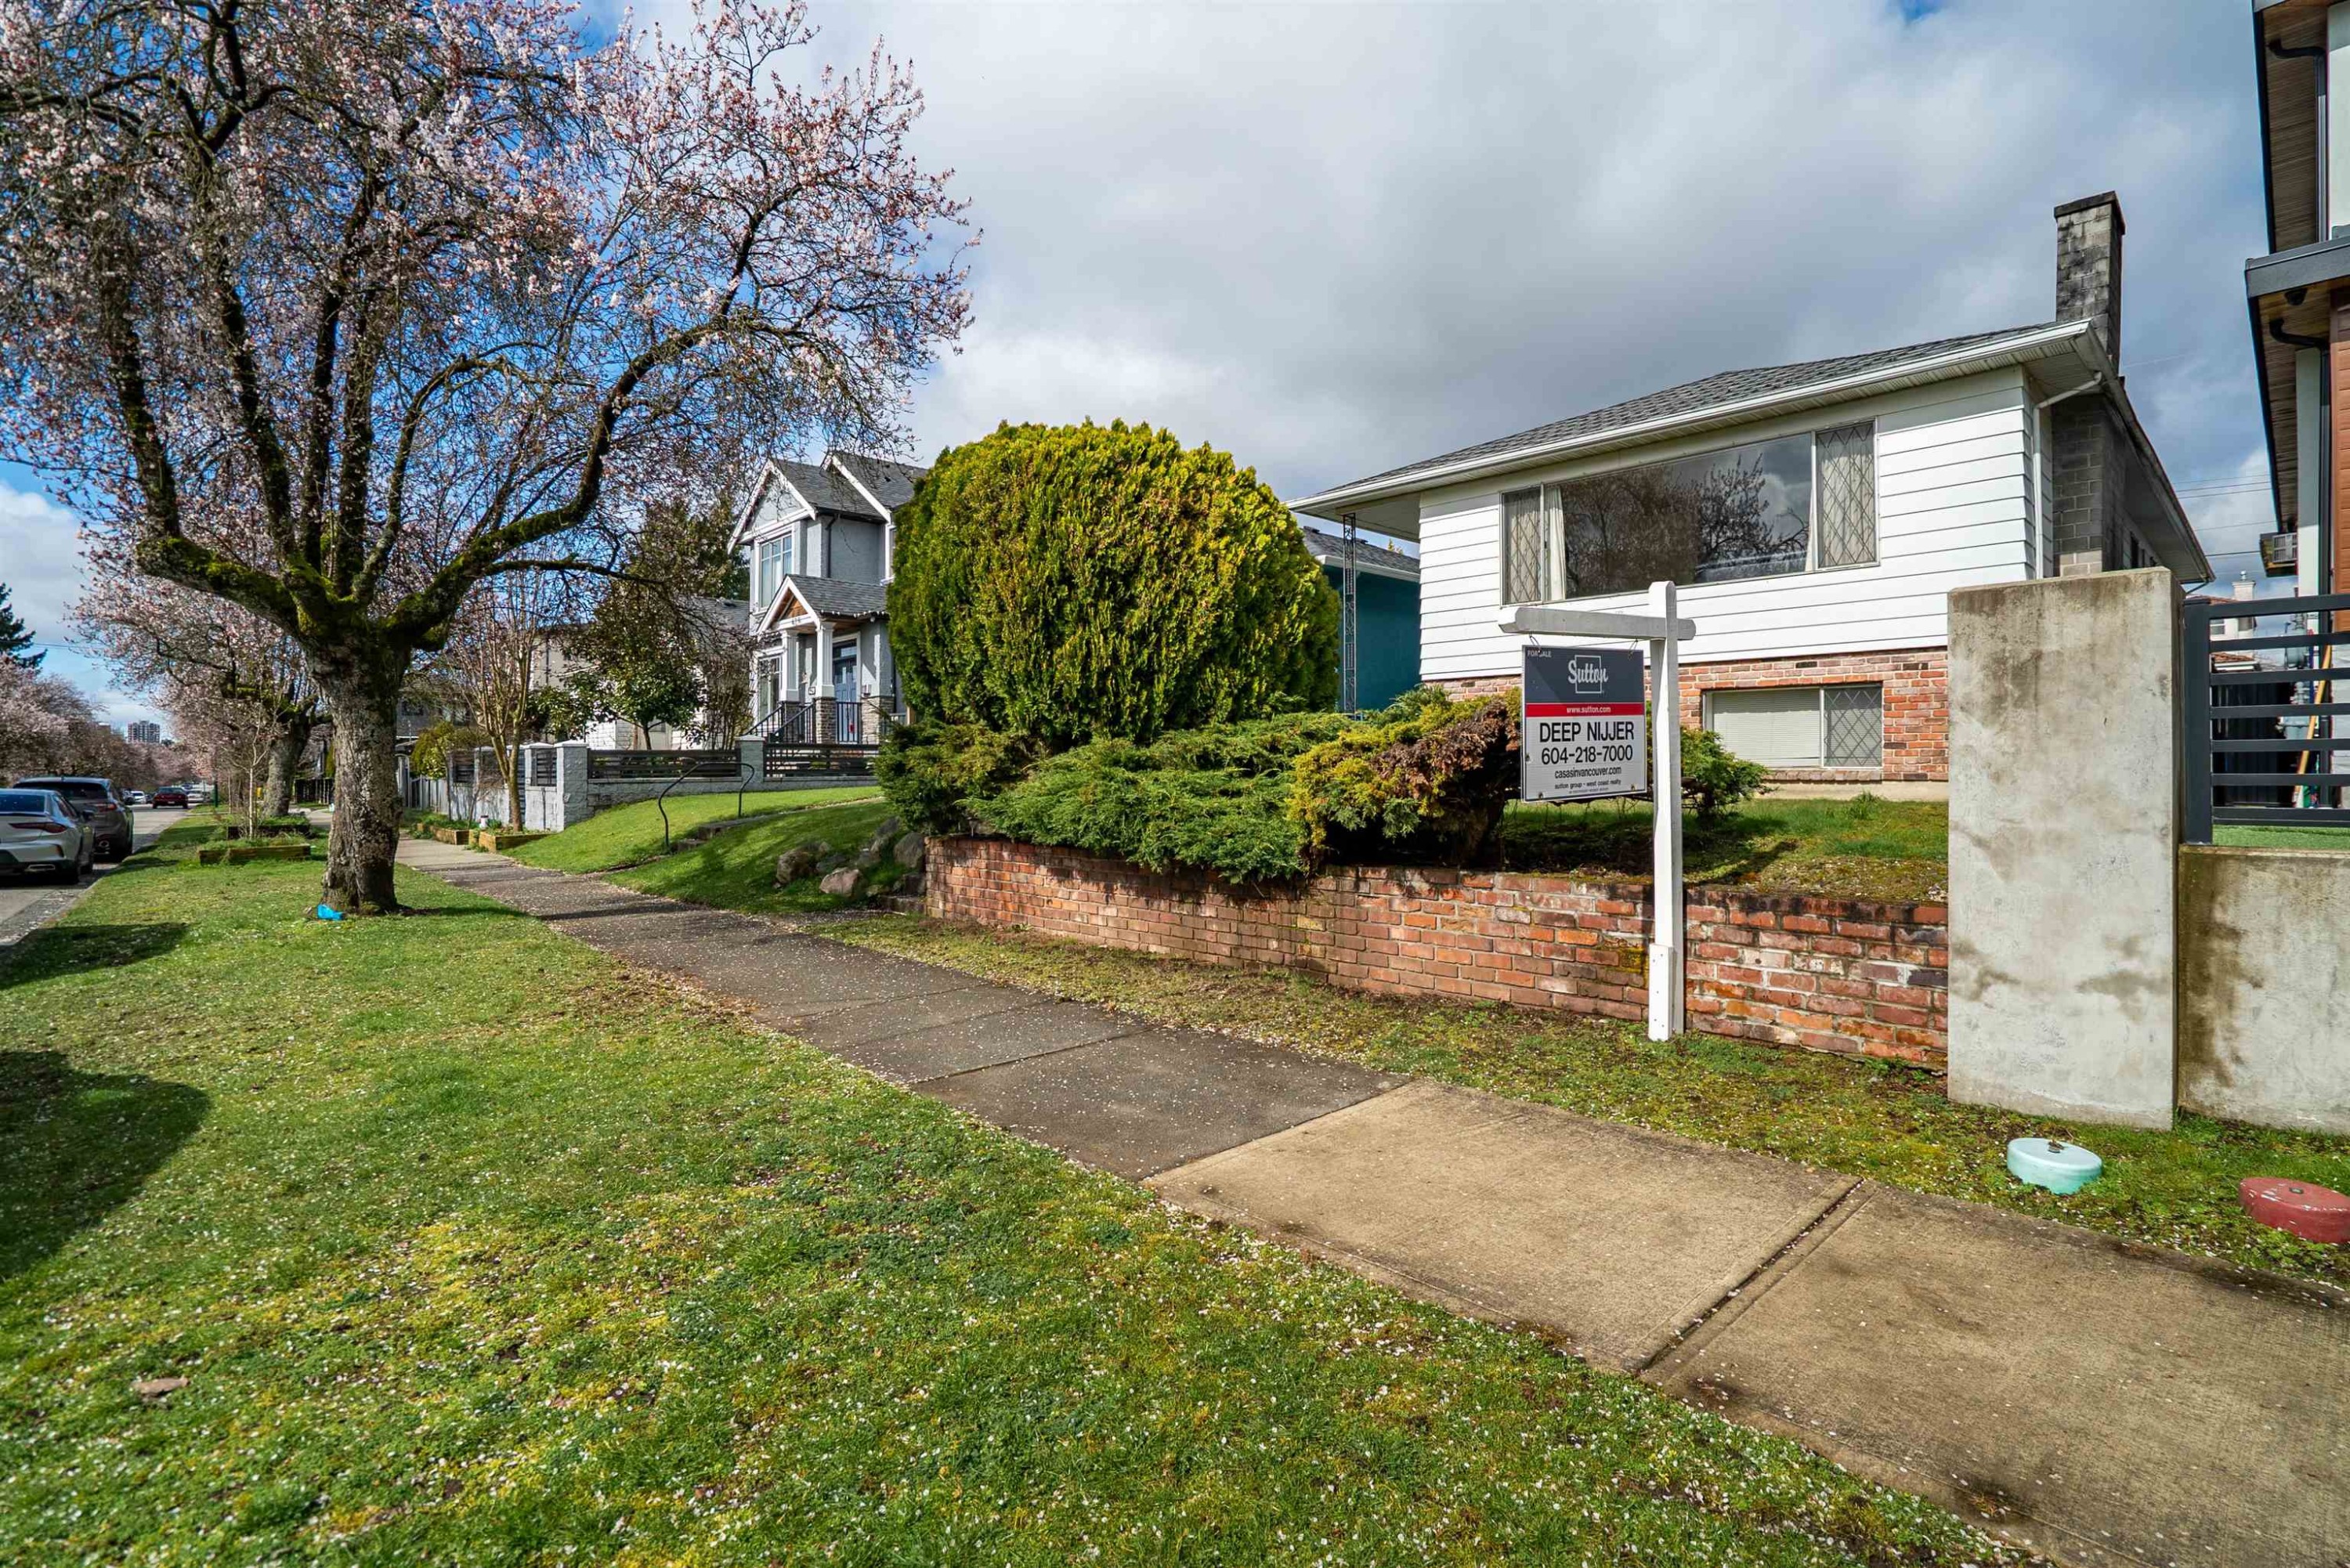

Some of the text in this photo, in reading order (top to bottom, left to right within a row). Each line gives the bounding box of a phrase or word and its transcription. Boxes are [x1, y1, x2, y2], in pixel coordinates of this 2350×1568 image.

[1568, 659, 1609, 684] Sutton
[1539, 721, 1635, 742] DEEP NIJJER
[1542, 745, 1633, 765] 604-218-7000
[1554, 767, 1622, 779] casasinvancouver.com
